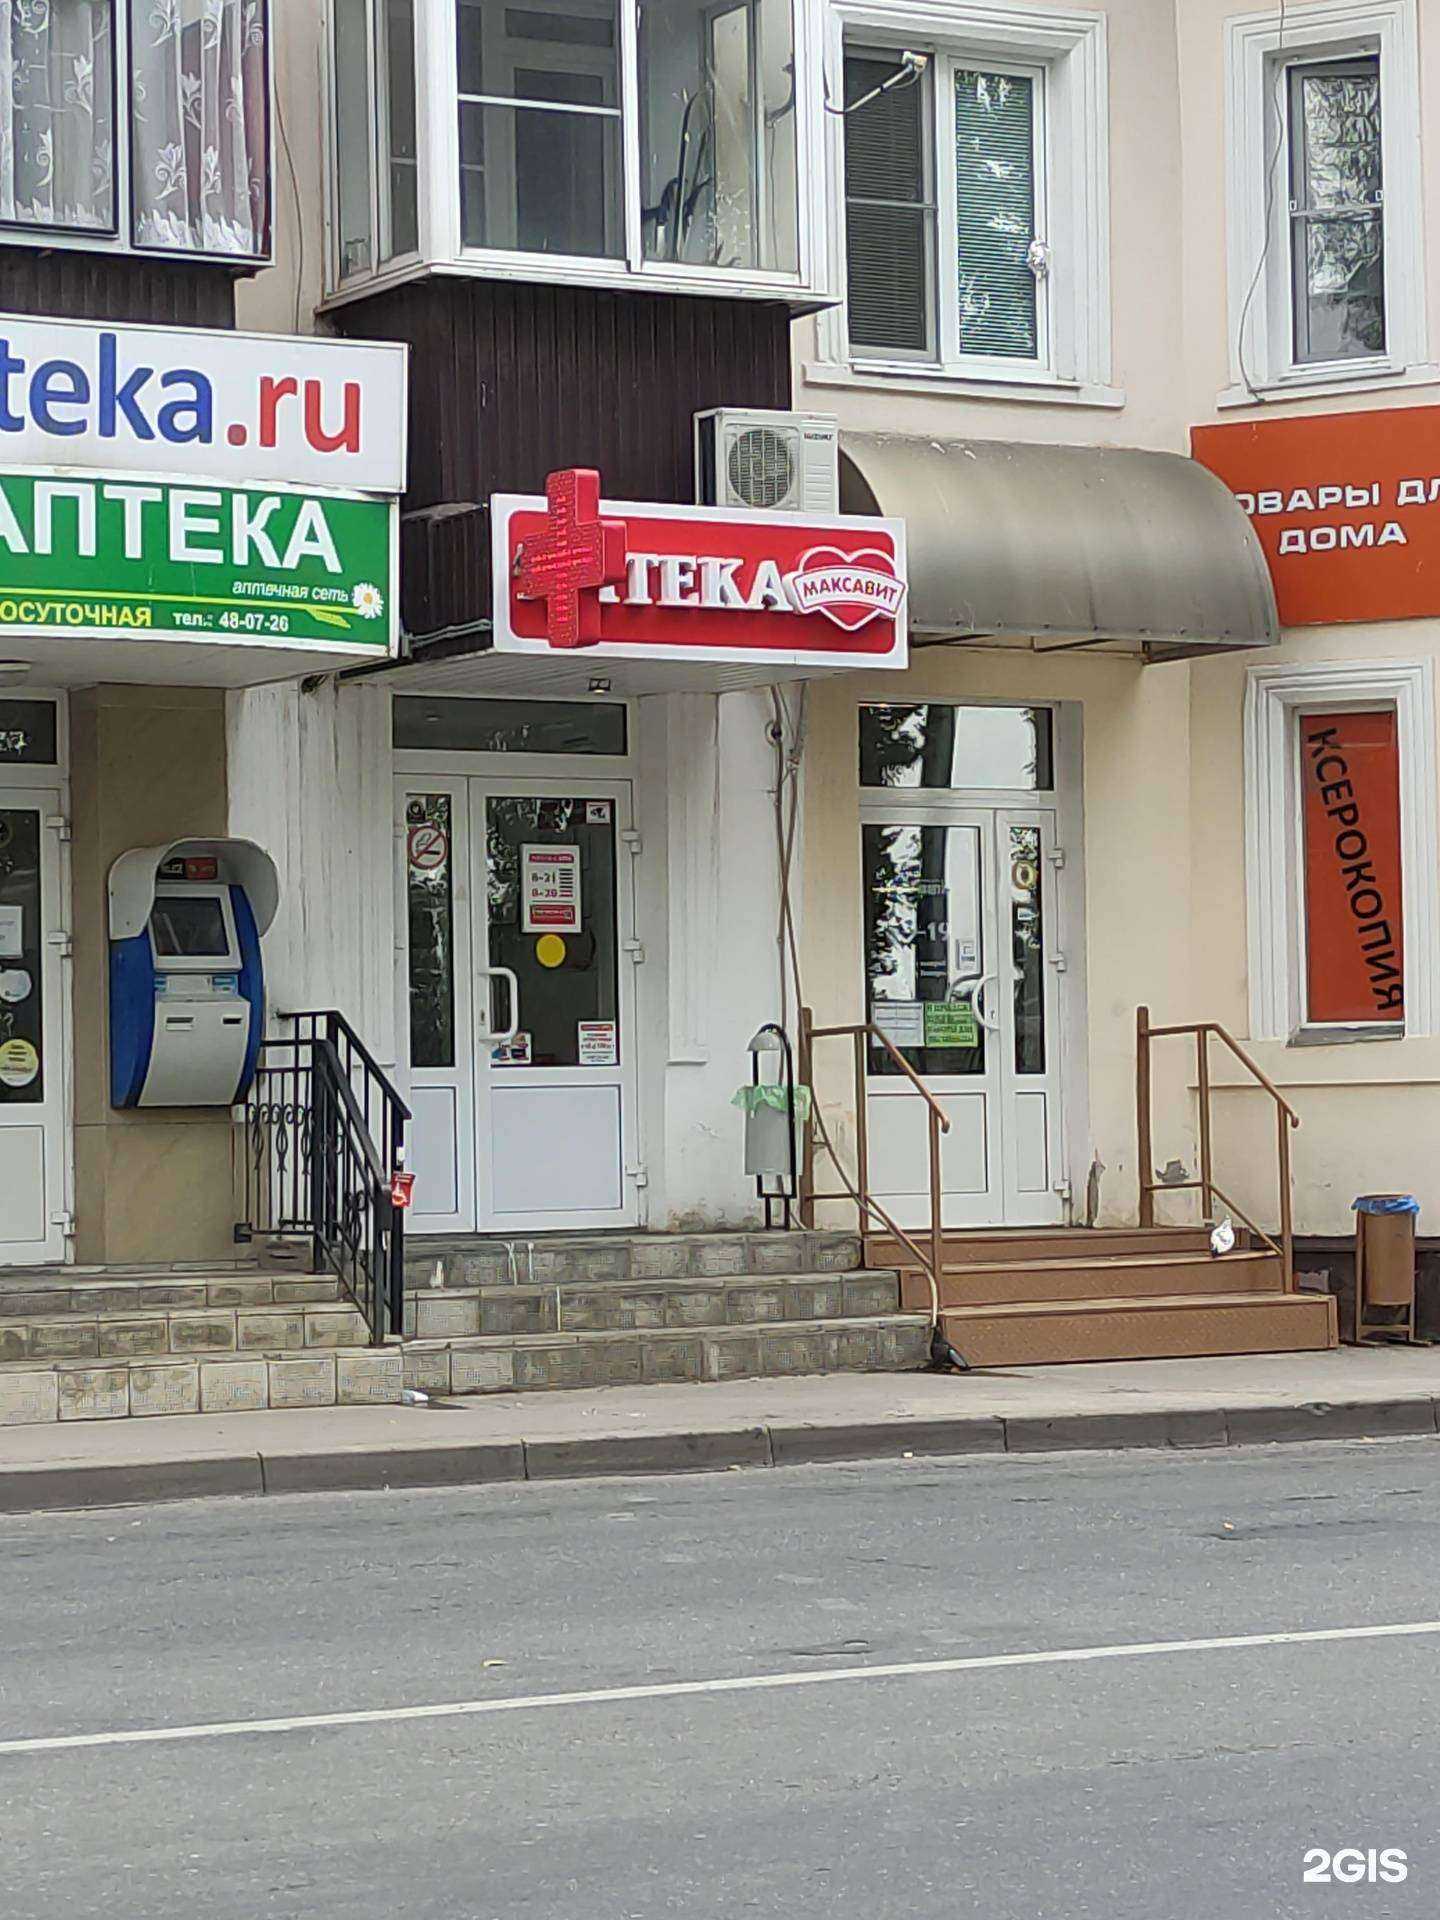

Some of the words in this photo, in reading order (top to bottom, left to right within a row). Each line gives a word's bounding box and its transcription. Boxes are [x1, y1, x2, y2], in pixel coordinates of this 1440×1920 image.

[1279, 522, 1407, 554] ДОМА
[232, 580, 309, 600] аптечная
[312, 586, 348, 602] сеть
[803, 577, 898, 604] МАКСАВИТ
[1308, 727, 1404, 1010] КСЕРОКОПИЯ
